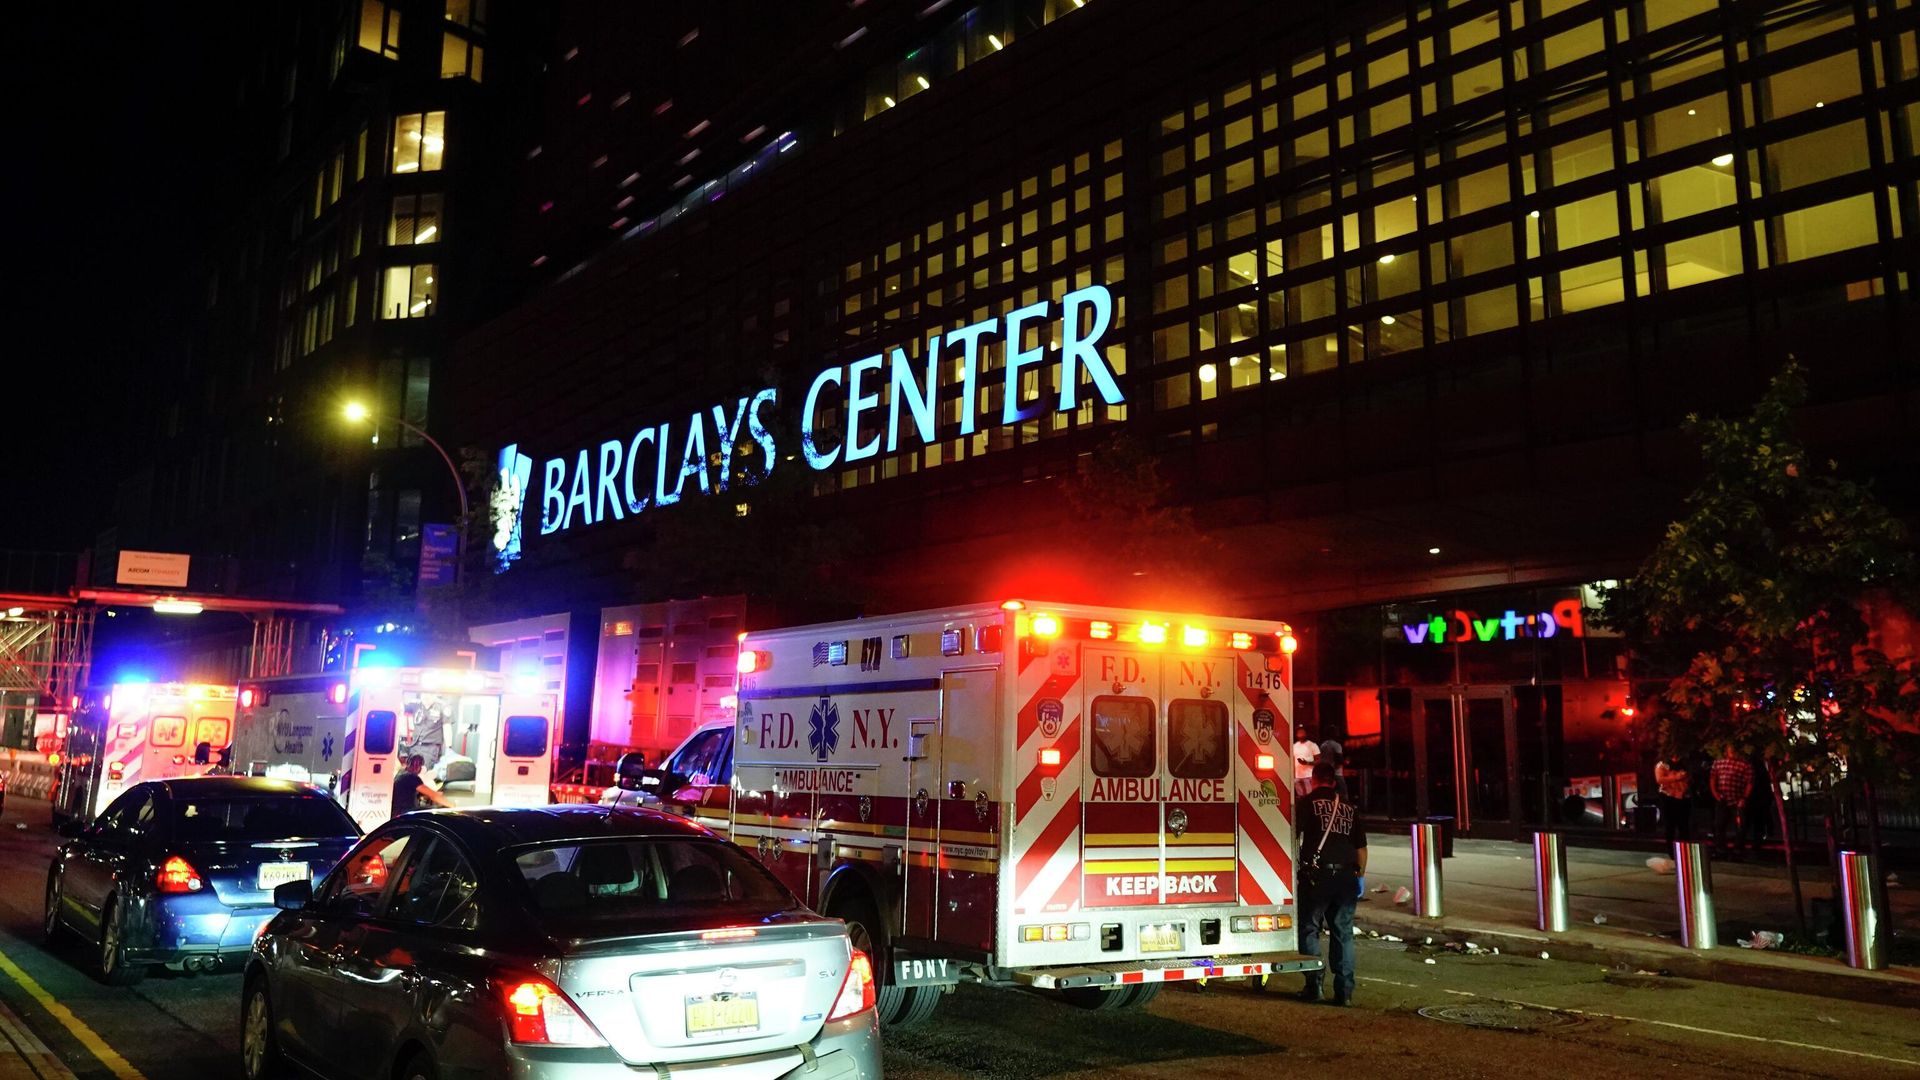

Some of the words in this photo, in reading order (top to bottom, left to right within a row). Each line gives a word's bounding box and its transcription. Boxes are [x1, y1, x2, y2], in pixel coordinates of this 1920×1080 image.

[540, 387, 777, 535] BARCLAYS
[801, 285, 1127, 471] CENTER
[1101, 655, 1146, 683] F.D.
[1180, 660, 1221, 687] N.Y.
[1248, 671, 1281, 690] 1416
[759, 712, 798, 749] F.D.
[851, 708, 898, 749] N.Y.
[781, 769, 854, 793] AMBULANCE
[1090, 777, 1226, 802] AMBULANCE
[1248, 790, 1269, 799] FDNY
[1258, 798, 1280, 807] green
[1312, 799, 1354, 820] FDNY
[1321, 814, 1353, 836] EMT
[1105, 875, 1159, 897] KEEP
[1165, 874, 1218, 895] BACK
[819, 970, 838, 980] SV
[902, 958, 949, 980] FDNY
[575, 989, 625, 1000] VERSA
